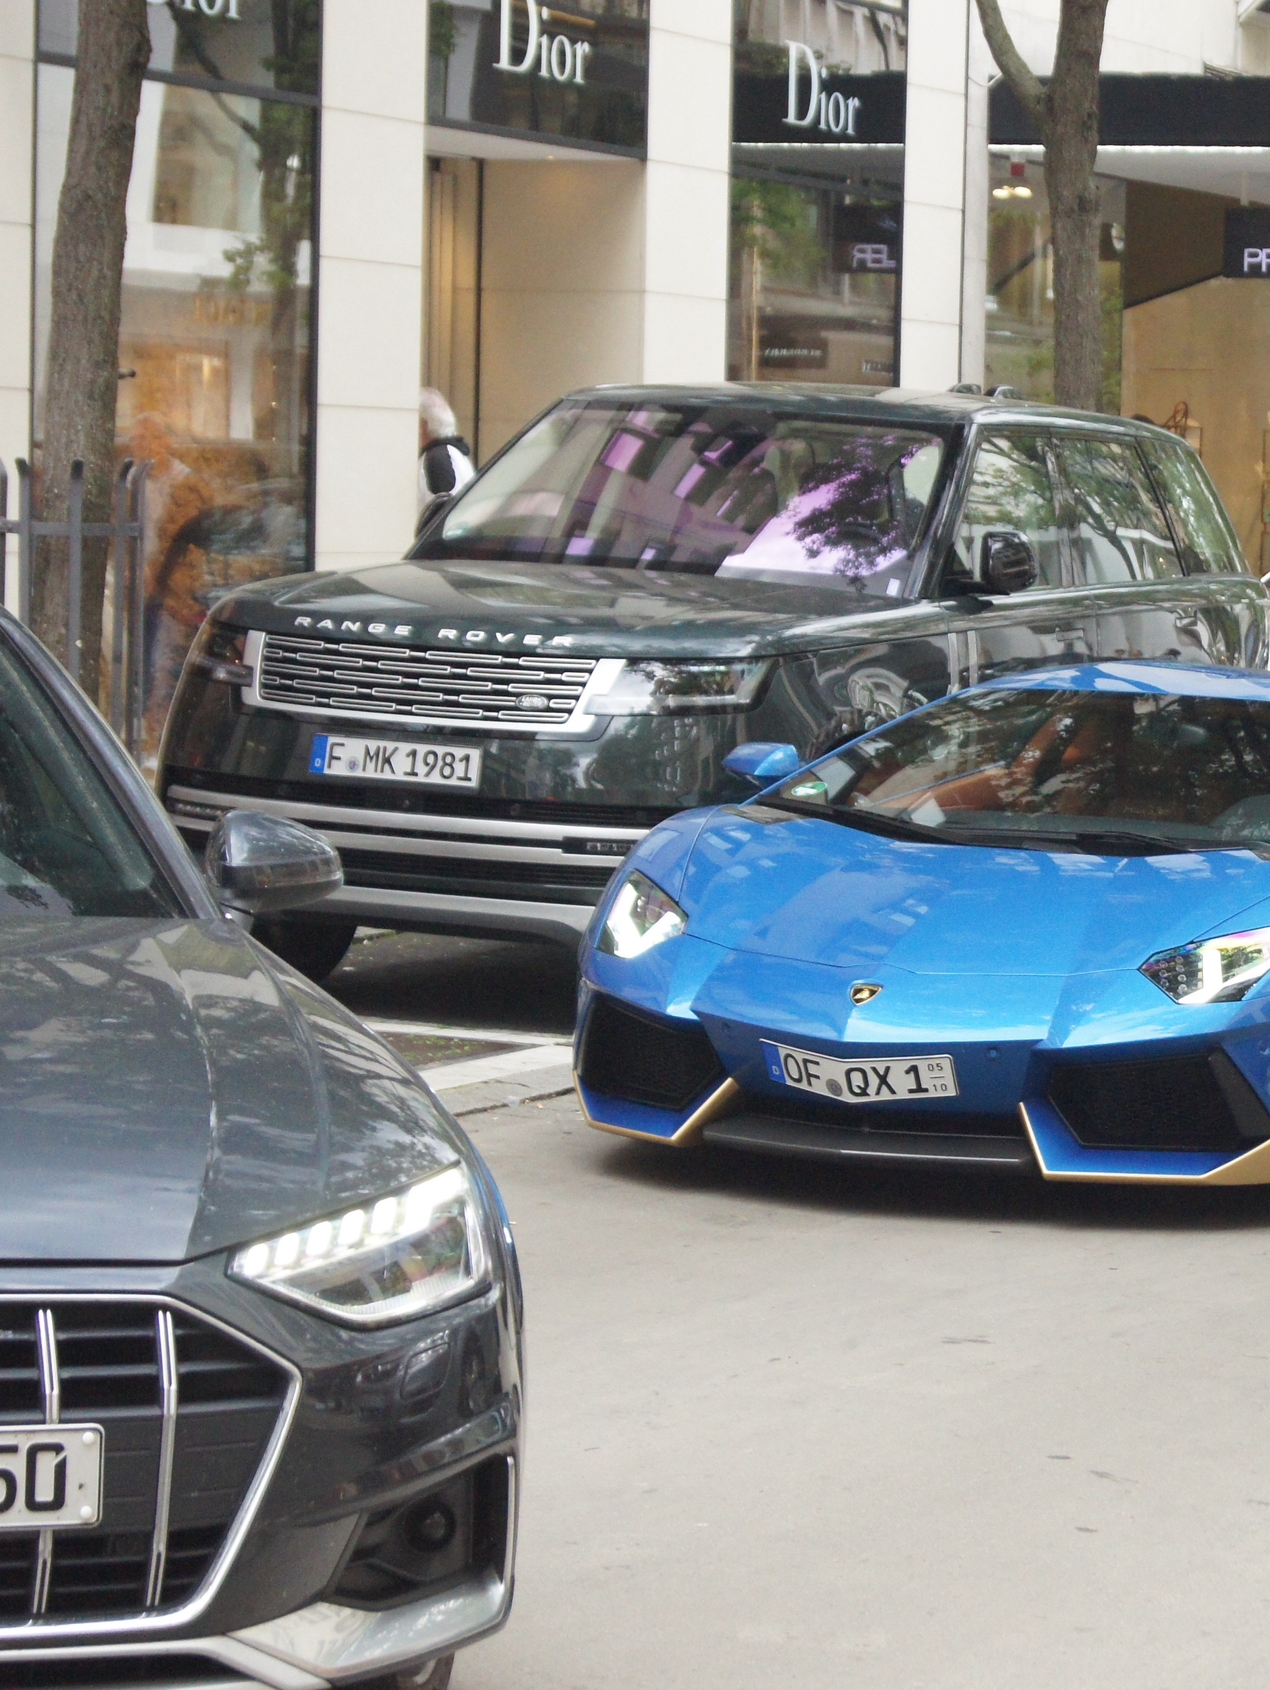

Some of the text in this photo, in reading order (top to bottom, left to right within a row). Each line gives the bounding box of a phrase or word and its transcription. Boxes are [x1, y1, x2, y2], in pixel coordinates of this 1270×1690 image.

[492, 0, 593, 85] Dior
[781, 39, 863, 137] Dior
[294, 616, 574, 647] RANGE ROVER
[327, 742, 473, 782] F MK 1981
[783, 1053, 929, 1097] OF QX 1
